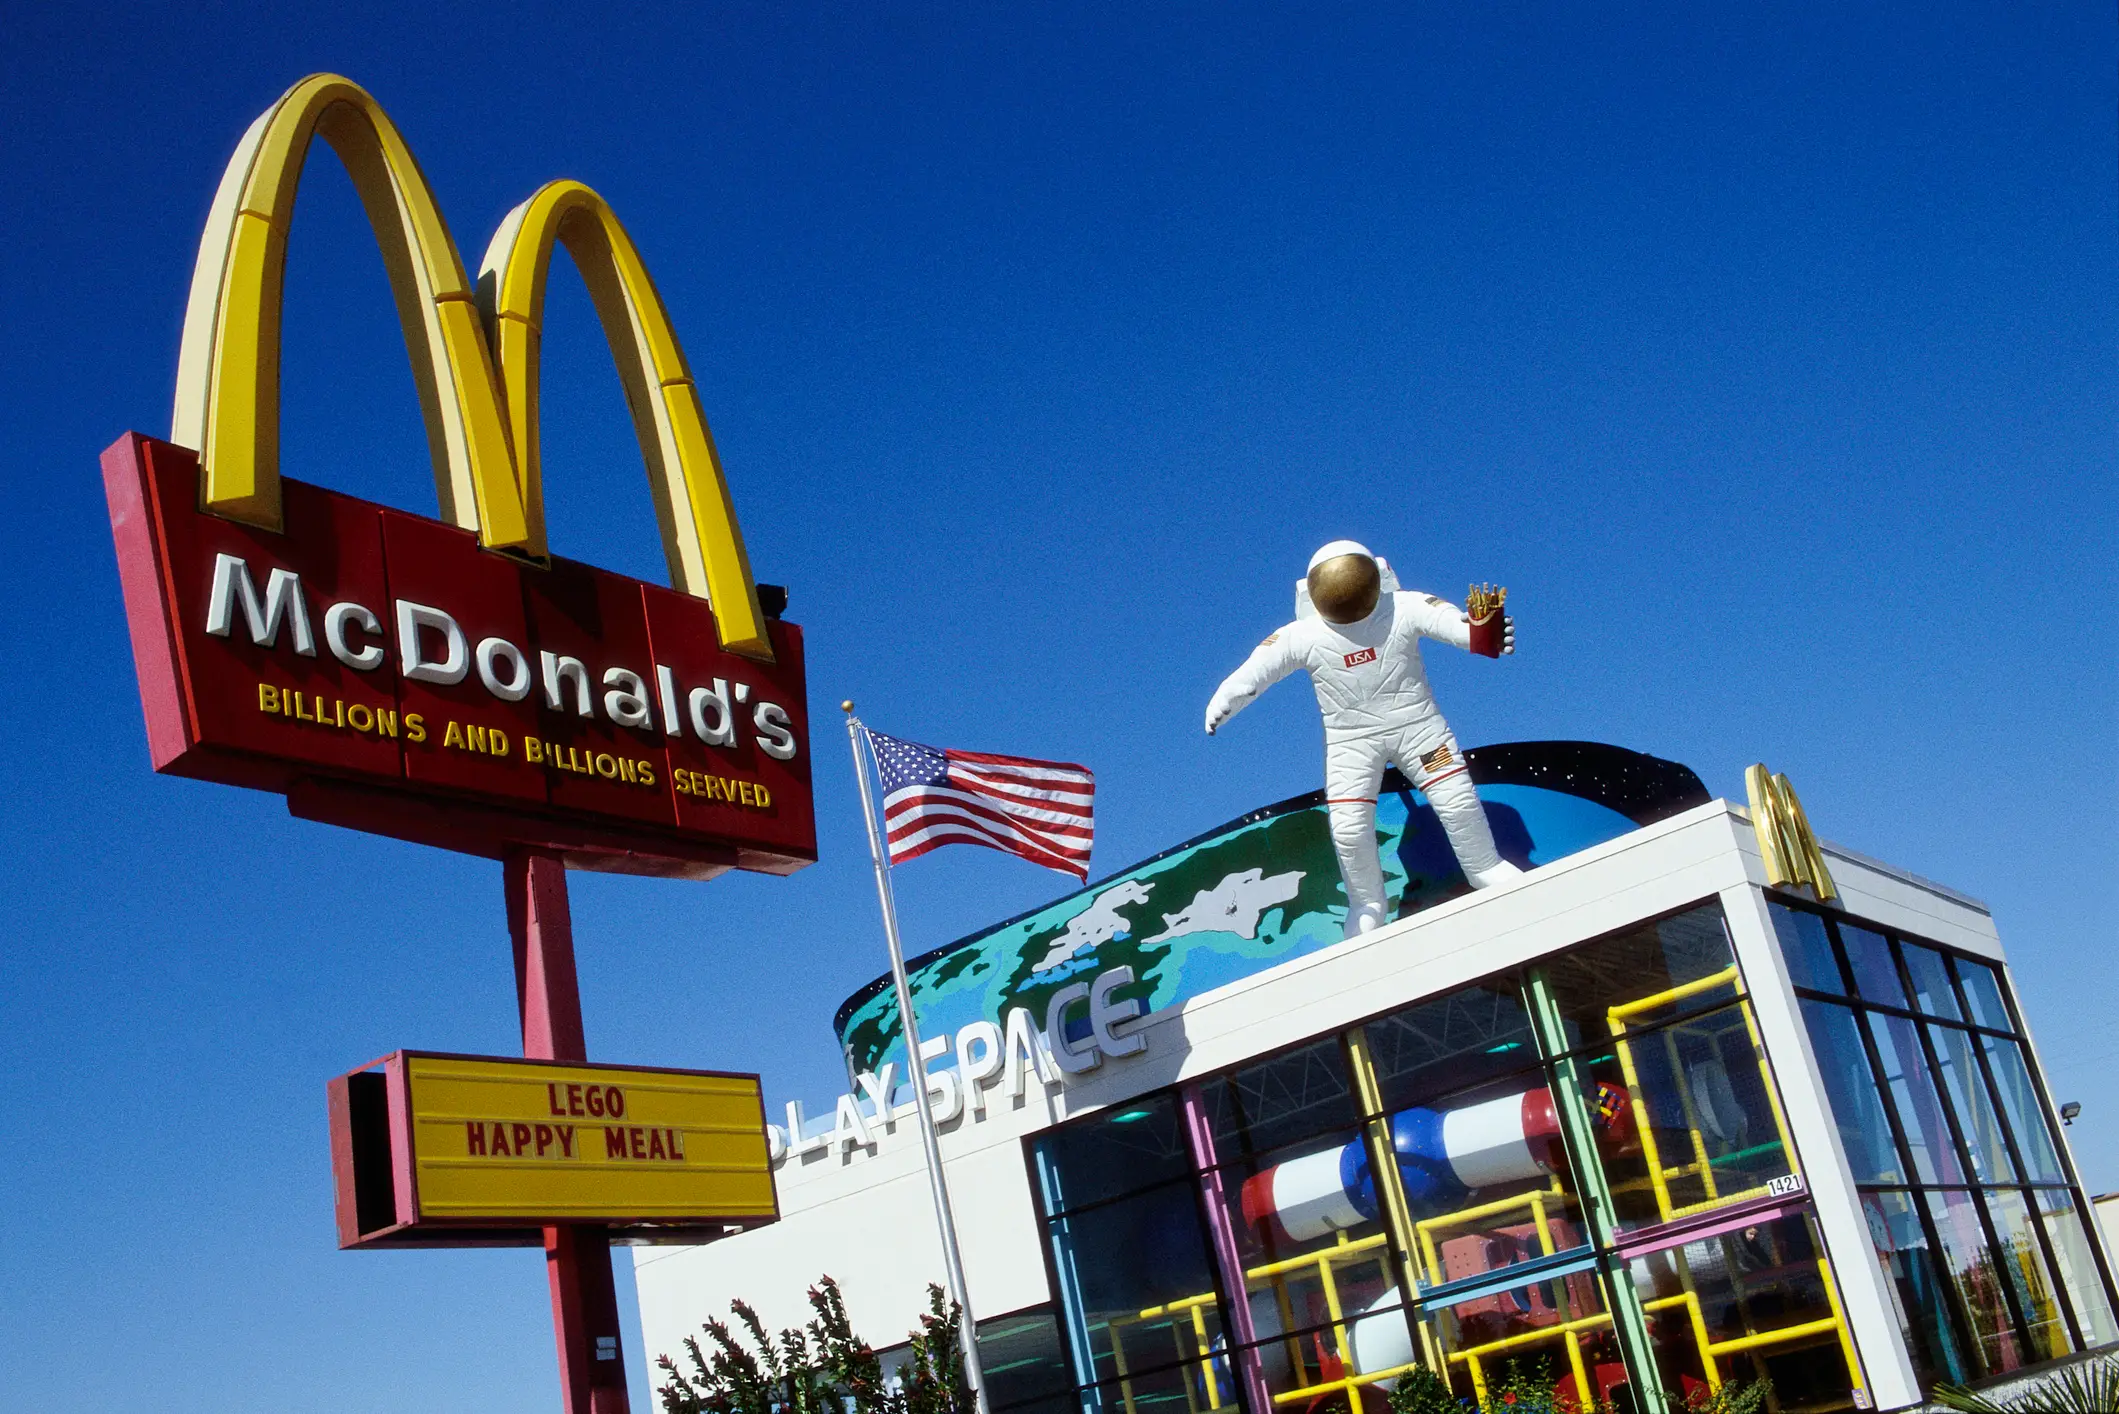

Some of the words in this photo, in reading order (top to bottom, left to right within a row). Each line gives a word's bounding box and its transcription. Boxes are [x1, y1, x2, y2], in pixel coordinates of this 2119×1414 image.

[206, 553, 797, 761] McDonald's
[1347, 650, 1373, 665] USA
[258, 684, 427, 744] BILLIONS
[443, 721, 510, 757] AND
[525, 736, 656, 786] BILLIONS
[675, 768, 771, 809] SERVED
[908, 965, 1147, 1122] SPACE
[548, 1083, 625, 1118] LEGO
[466, 1121, 575, 1158] HAPPY
[605, 1126, 684, 1161] MEAL
[1769, 1174, 1801, 1195] 1421
